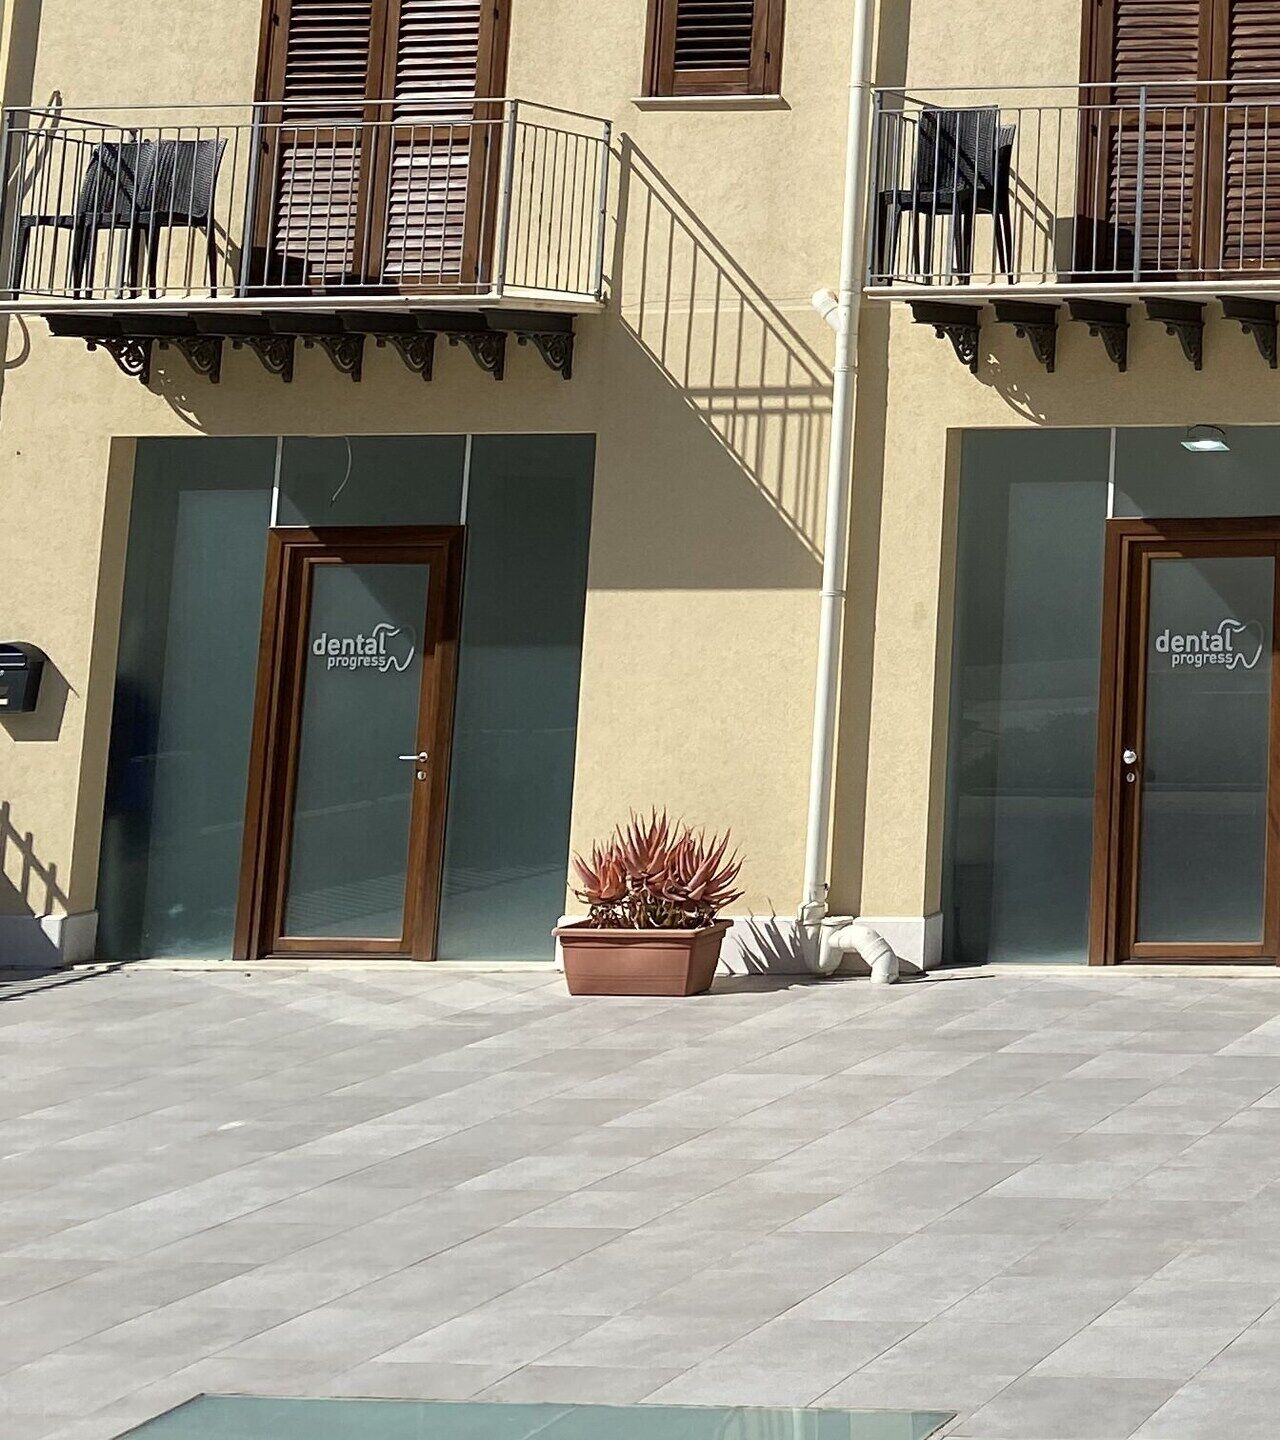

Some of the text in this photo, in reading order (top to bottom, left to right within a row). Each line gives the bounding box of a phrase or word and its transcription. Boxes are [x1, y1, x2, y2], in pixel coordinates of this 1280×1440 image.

[313, 632, 386, 656] dental
[1155, 628, 1233, 653] dental
[327, 656, 387, 671] progress
[1171, 652, 1233, 668] progress
